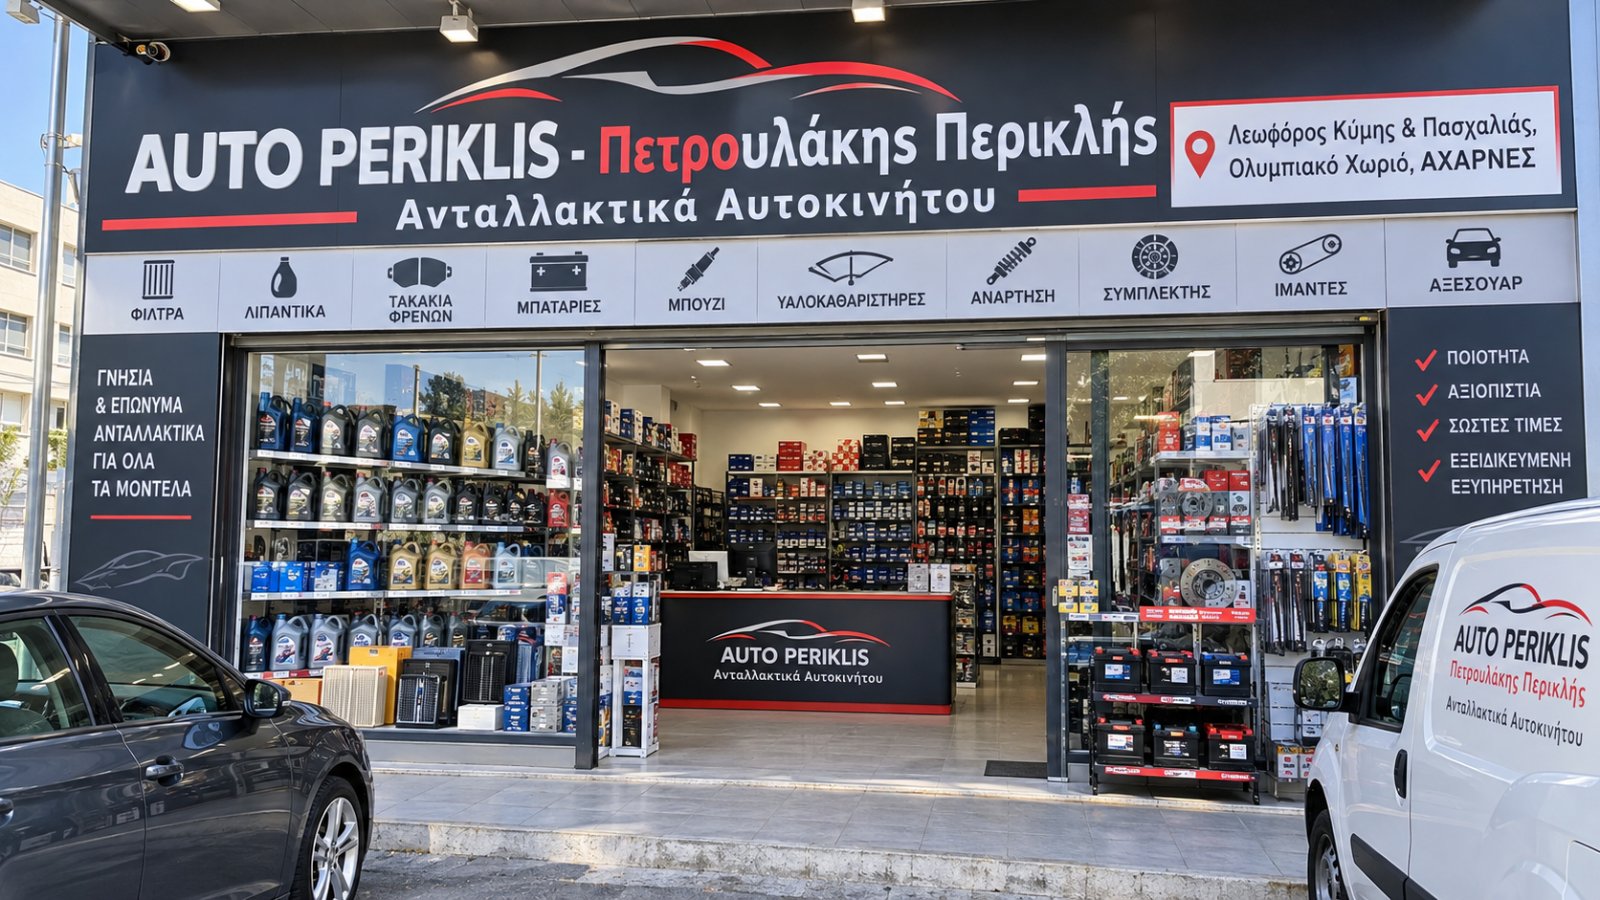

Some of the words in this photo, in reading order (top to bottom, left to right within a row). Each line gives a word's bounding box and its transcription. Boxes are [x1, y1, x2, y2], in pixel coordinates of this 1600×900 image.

[1229, 124, 1326, 148] Λεωφόρος
[1334, 119, 1395, 144] Κύμης
[1402, 117, 1416, 138] &
[1423, 112, 1537, 140] Πασχαλιάς,
[125, 128, 303, 193] AUTO
[320, 120, 560, 186] PERIKLIS
[571, 149, 585, 160] -
[600, 114, 917, 183] Πετρουλάκης
[936, 101, 1157, 171] Περικλής
[1229, 154, 1338, 182] Ολυμπιακό
[1346, 152, 1414, 177] Χωριό,
[1421, 147, 1536, 171] ΑΧΑΡΝΕΣ
[396, 188, 697, 231] Ανταλλακτικά
[716, 180, 995, 223] Αυτοκινήτου
[1275, 281, 1348, 296] ΙΜΑΝΤΕΣ
[1430, 276, 1522, 292] ΑΞΕΣΟΥΑΡ
[777, 292, 926, 309] ΥΑΛΟΚΑΘΑΡΙΣΤΗΡΕΣ
[971, 289, 1055, 305] ΑΝΑΡΤΗΣΗ
[1103, 284, 1211, 301] ΣΥΜΠΛΕΚΤΗΣ
[389, 294, 453, 308] ΤΑΚΑΚΙΑ
[517, 299, 601, 314] ΜΠΑΤΑΡΙΕΣ
[669, 297, 725, 312] ΜΠΟΥΖΙ
[131, 307, 184, 321] ΦΙΛΤΡΑ
[244, 304, 326, 319] ΛΙΠΑΝΤΙΚΑ
[389, 309, 452, 324] ΦΡΕΝΩΝ
[1448, 349, 1529, 365] ΠΟΙΟΤΗΤΑ
[97, 369, 153, 386] ΓΝΗΣΙΑ
[1448, 383, 1541, 399] ΑΞΙΟΠΙΣΤΙΑ
[96, 397, 106, 414] &
[111, 396, 183, 413] ΕΠΩΝΥΜΑ
[1449, 418, 1509, 433] ΣΩΣΤΕΣ
[1514, 417, 1562, 432] ΤΙΜΕΣ
[94, 425, 205, 442] ΑΝΤΑΛΛΑΚΤΙΚΑ
[93, 453, 117, 469] ΓΙΑ
[122, 452, 155, 469] ΟΛΑ
[1451, 452, 1571, 468] ΕΞΕΙΔΙΚΕΥΜΕΝΗ
[92, 480, 110, 497] ΤΑ
[116, 480, 192, 497] ΜΟΝΤΕΛΑ
[1452, 479, 1563, 494] ΕΞΥΠΗΡΕΤΗΣΗ
[1454, 625, 1499, 656] AUTO
[1502, 628, 1590, 669] PERIKLIS
[721, 647, 777, 664] AUTO
[785, 648, 869, 666] PERIKLIS
[713, 669, 800, 682] Ανταλλακτικά
[805, 671, 883, 685] Αυτοκινήτου
[1450, 660, 1519, 694] Πετρουλάκης
[1523, 672, 1586, 708] Περικλής
[1446, 696, 1507, 726] Ανταλλακτικά
[1511, 712, 1583, 746] Αυτοκινήτου
